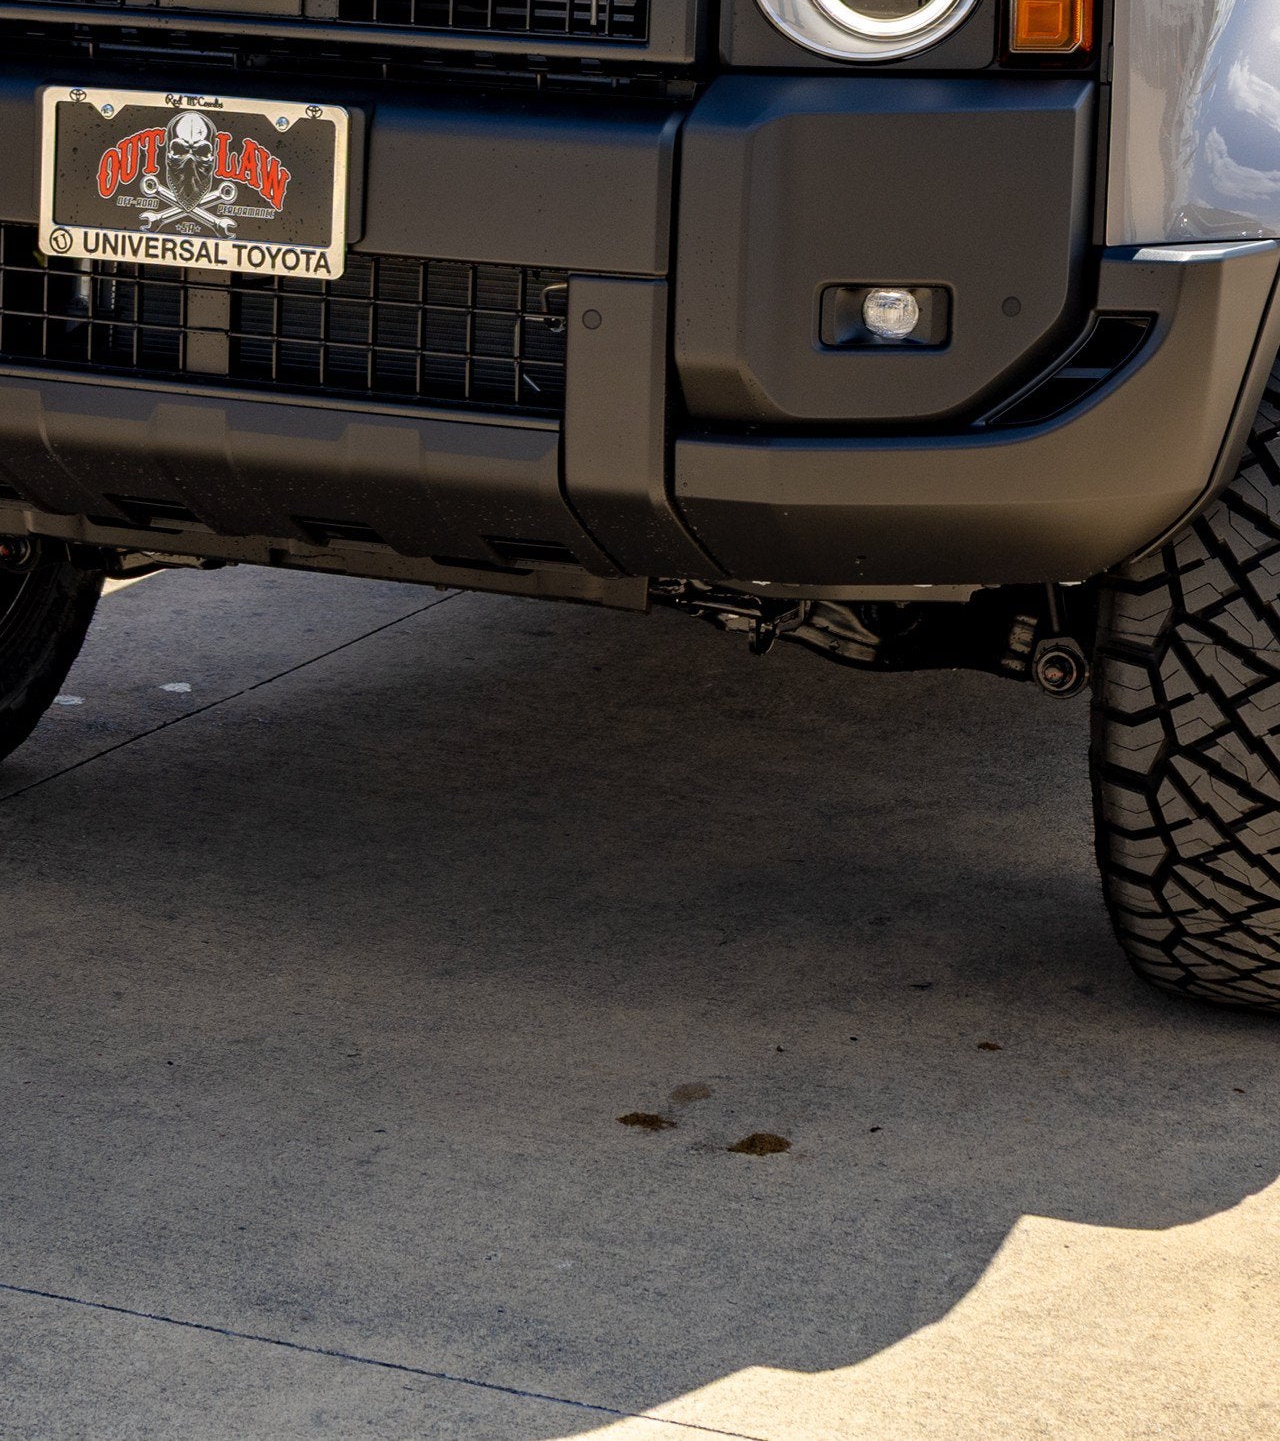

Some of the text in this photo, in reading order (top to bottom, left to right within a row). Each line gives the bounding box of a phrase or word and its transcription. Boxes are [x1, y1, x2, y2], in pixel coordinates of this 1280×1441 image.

[96, 127, 291, 212] OUT LAW
[217, 205, 275, 219] PERFORMANCE
[83, 231, 228, 266] UNIVERSAL
[232, 243, 332, 275] TOYOTA
